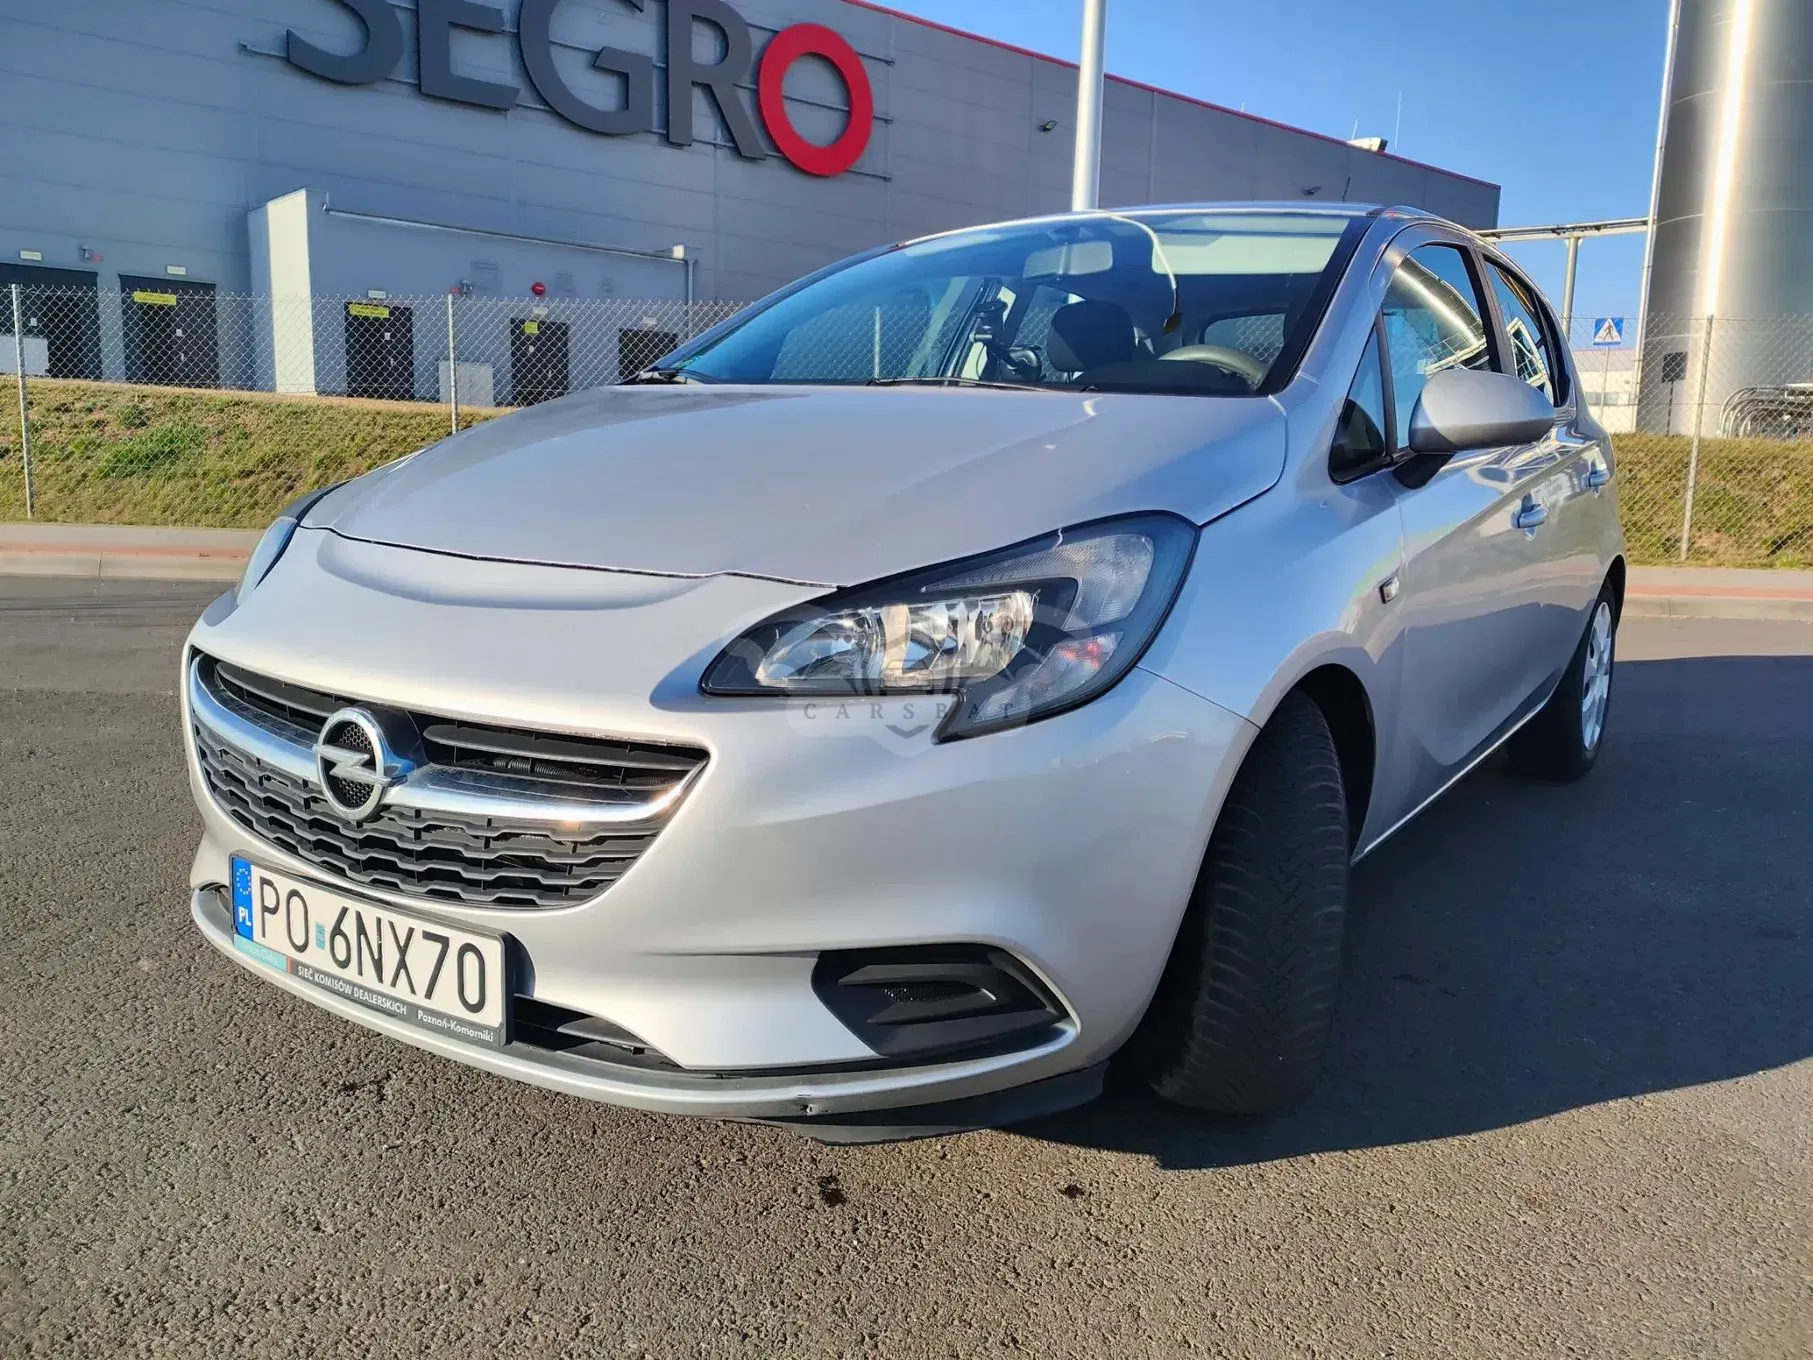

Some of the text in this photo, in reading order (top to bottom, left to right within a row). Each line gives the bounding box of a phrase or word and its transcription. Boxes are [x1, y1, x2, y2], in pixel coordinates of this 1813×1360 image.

[238, 906, 252, 926] PL
[259, 876, 486, 1013] PO 6NX70
[314, 972, 353, 994] KOMISÓW
[354, 987, 407, 1015] DEALERSKICH
[417, 1010, 494, 1042] Poznań-Komorniki
